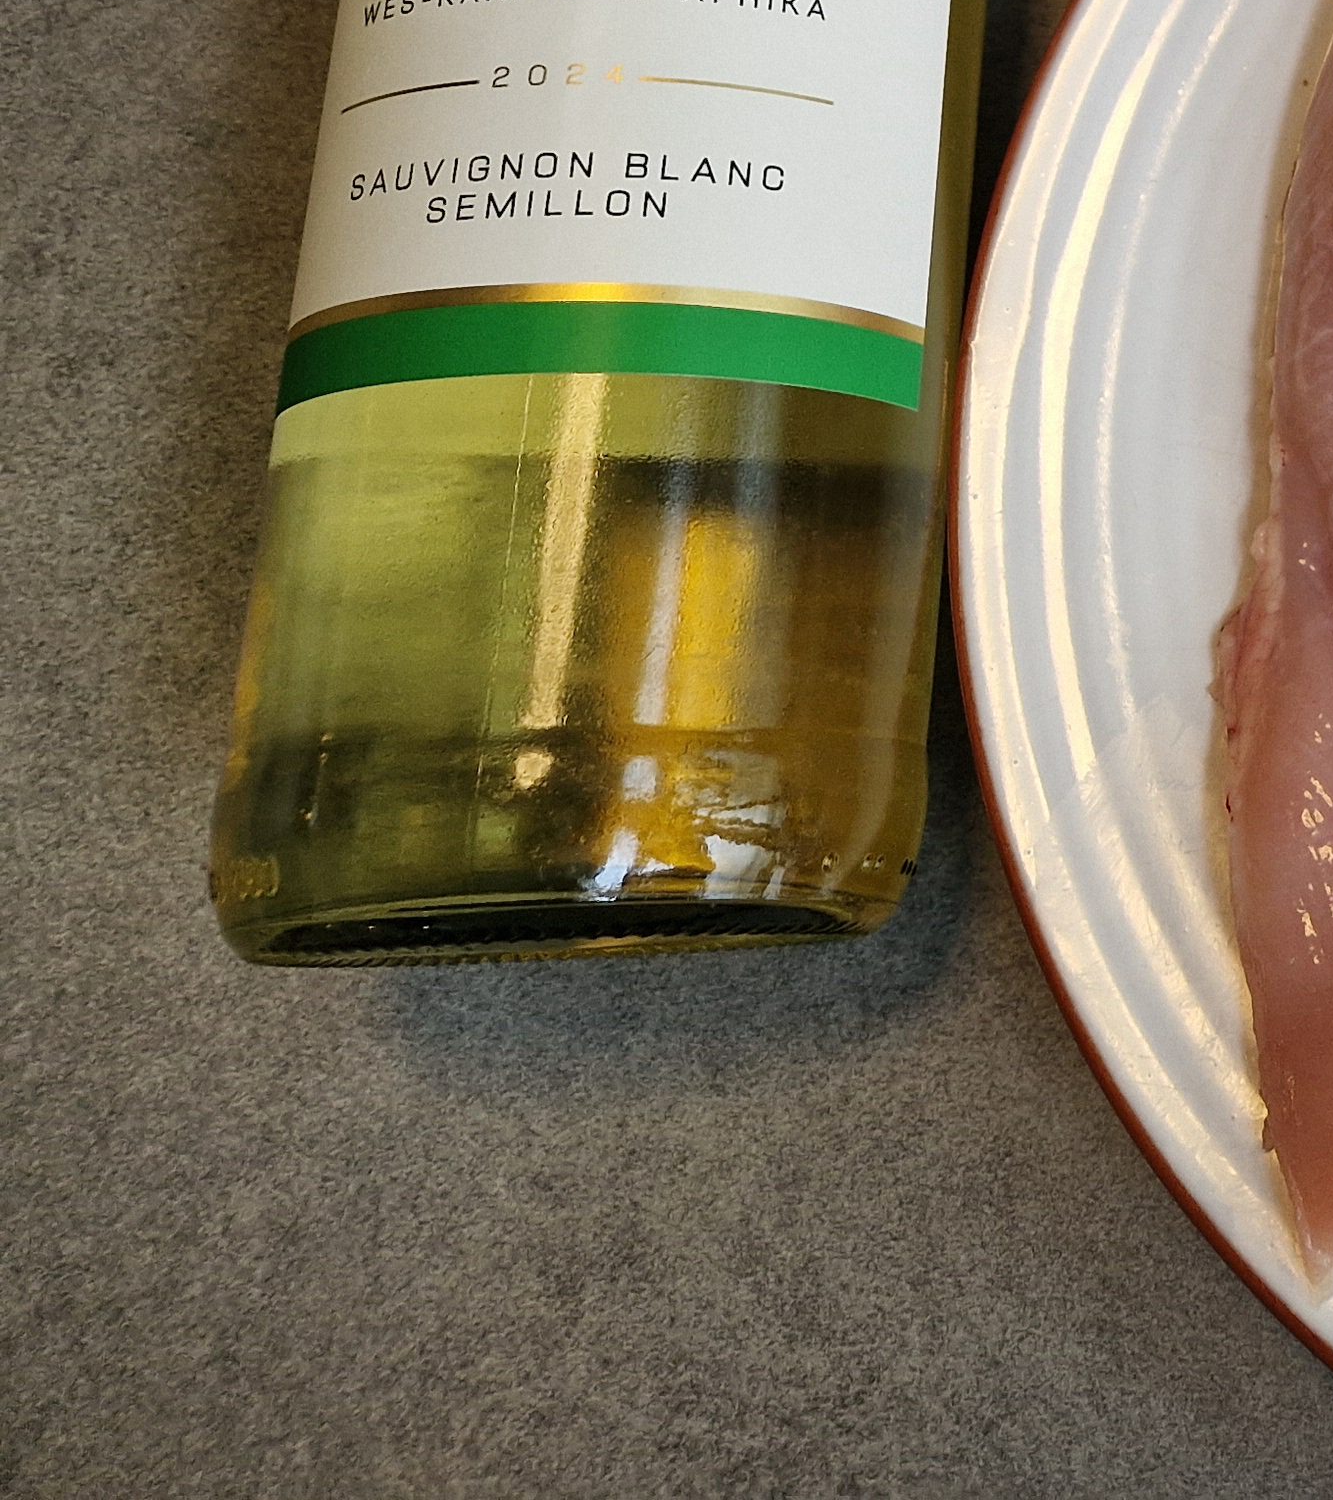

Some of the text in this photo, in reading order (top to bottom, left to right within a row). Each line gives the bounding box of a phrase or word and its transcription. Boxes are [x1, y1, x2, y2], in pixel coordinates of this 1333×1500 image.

[491, 62, 626, 89] 2024
[349, 150, 787, 202] SAUVIGNON BLANC
[426, 190, 670, 224] SEMILLON
